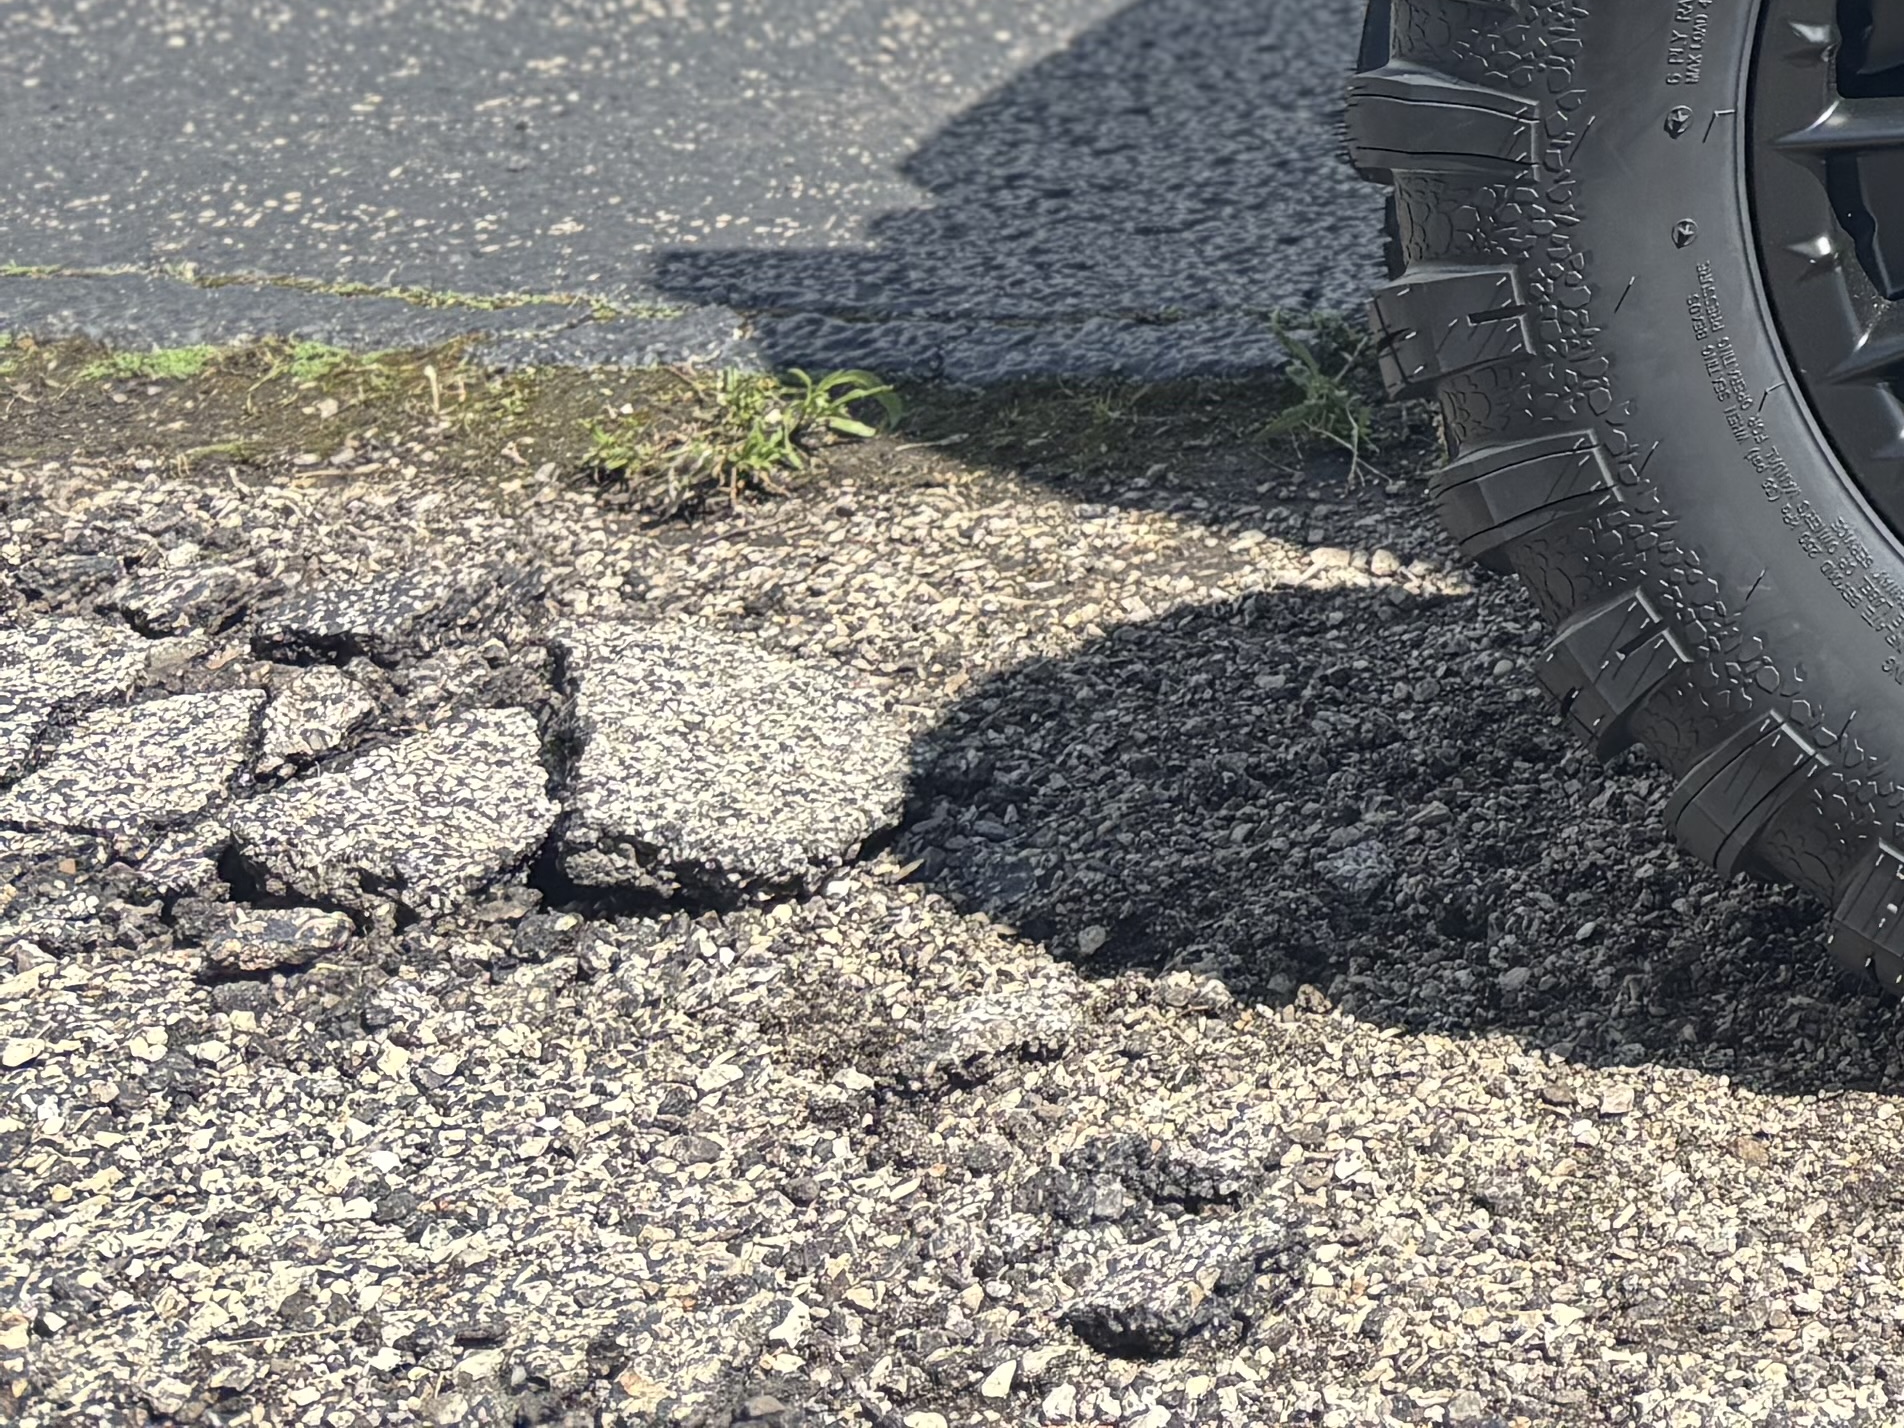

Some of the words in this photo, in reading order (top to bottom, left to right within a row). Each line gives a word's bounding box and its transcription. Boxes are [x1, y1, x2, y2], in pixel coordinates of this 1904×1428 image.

[1668, 29, 1688, 64] PLY
[1690, 12, 1708, 49] LOAD
[1685, 52, 1702, 84] MAX
[1748, 415, 1769, 444] FOR
[1858, 574, 1894, 614] LABEL
